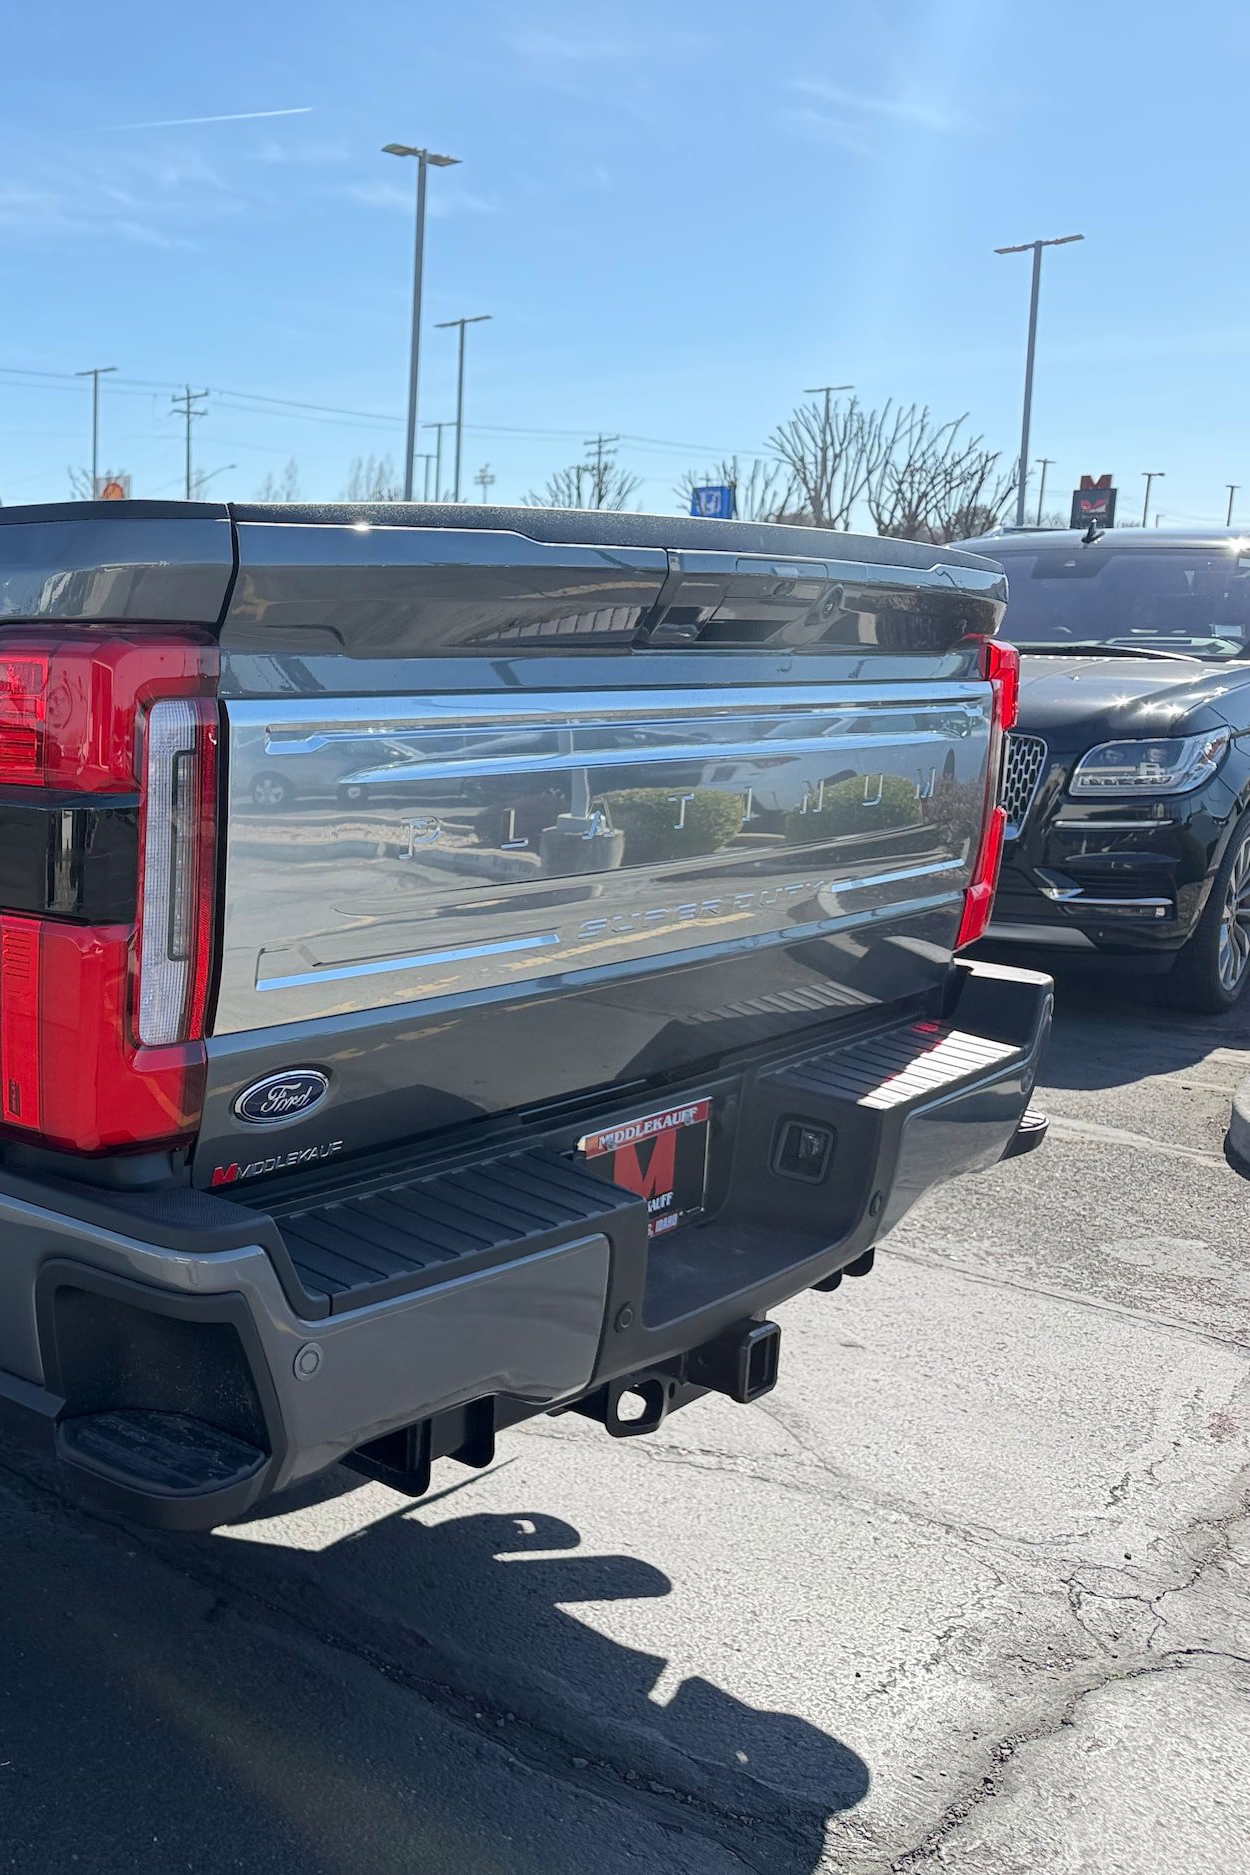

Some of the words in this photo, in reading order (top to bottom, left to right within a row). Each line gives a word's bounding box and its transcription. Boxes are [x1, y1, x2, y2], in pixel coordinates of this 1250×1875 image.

[398, 766, 937, 862] PLATINUM
[577, 897, 724, 940] SUPER
[733, 880, 825, 912] DUTY
[260, 1082, 314, 1113] Ford
